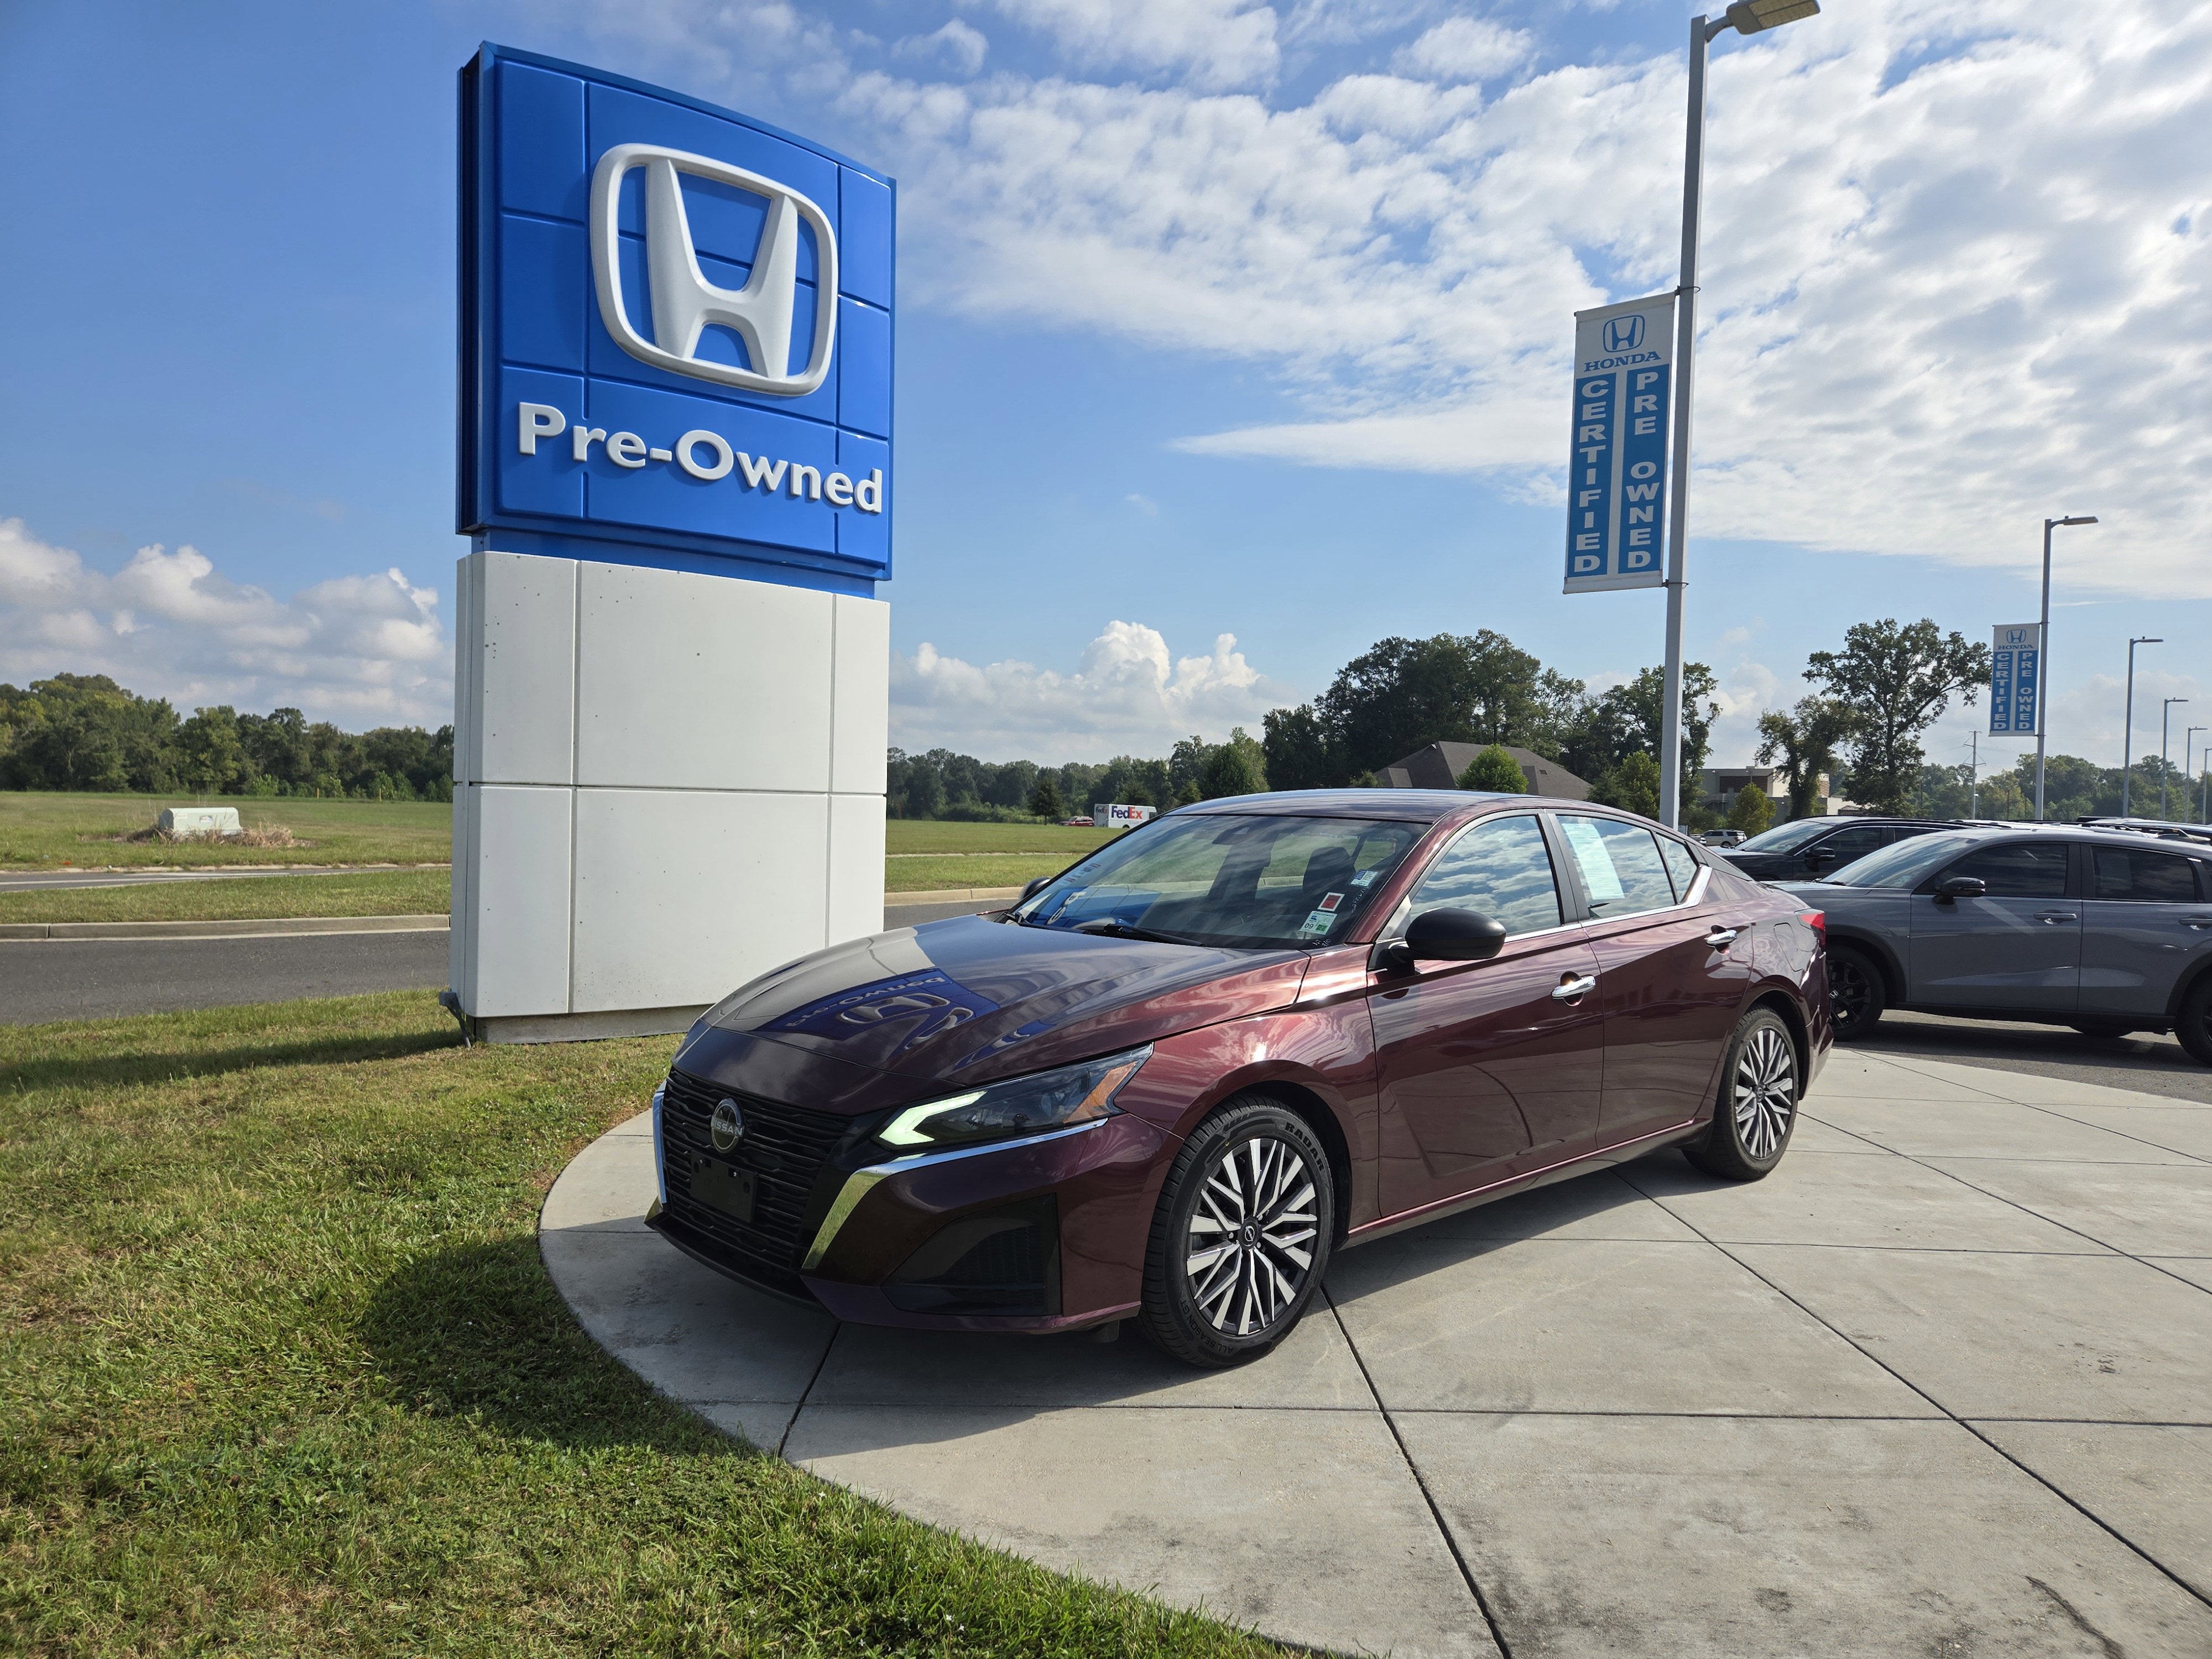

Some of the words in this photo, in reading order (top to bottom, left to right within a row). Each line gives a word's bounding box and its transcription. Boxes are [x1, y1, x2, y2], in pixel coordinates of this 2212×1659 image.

[1583, 351, 1662, 372] HONDA
[1633, 371, 1659, 435] PRE
[518, 401, 883, 514] Pre-Owned
[1573, 379, 1609, 573] CERTIFIED
[1626, 461, 1660, 568] OWNED
[2021, 652, 2033, 677] PRE
[1993, 653, 2009, 729] CERTIFIED
[2018, 687, 2033, 729] OWNED
[1112, 805, 1142, 819] FedEx
[1285, 1121, 1324, 1172] RADAR
[1180, 1300, 1190, 1315] GT
[1187, 1314, 1217, 1349] SEASON
[1218, 1343, 1234, 1354] ALL
